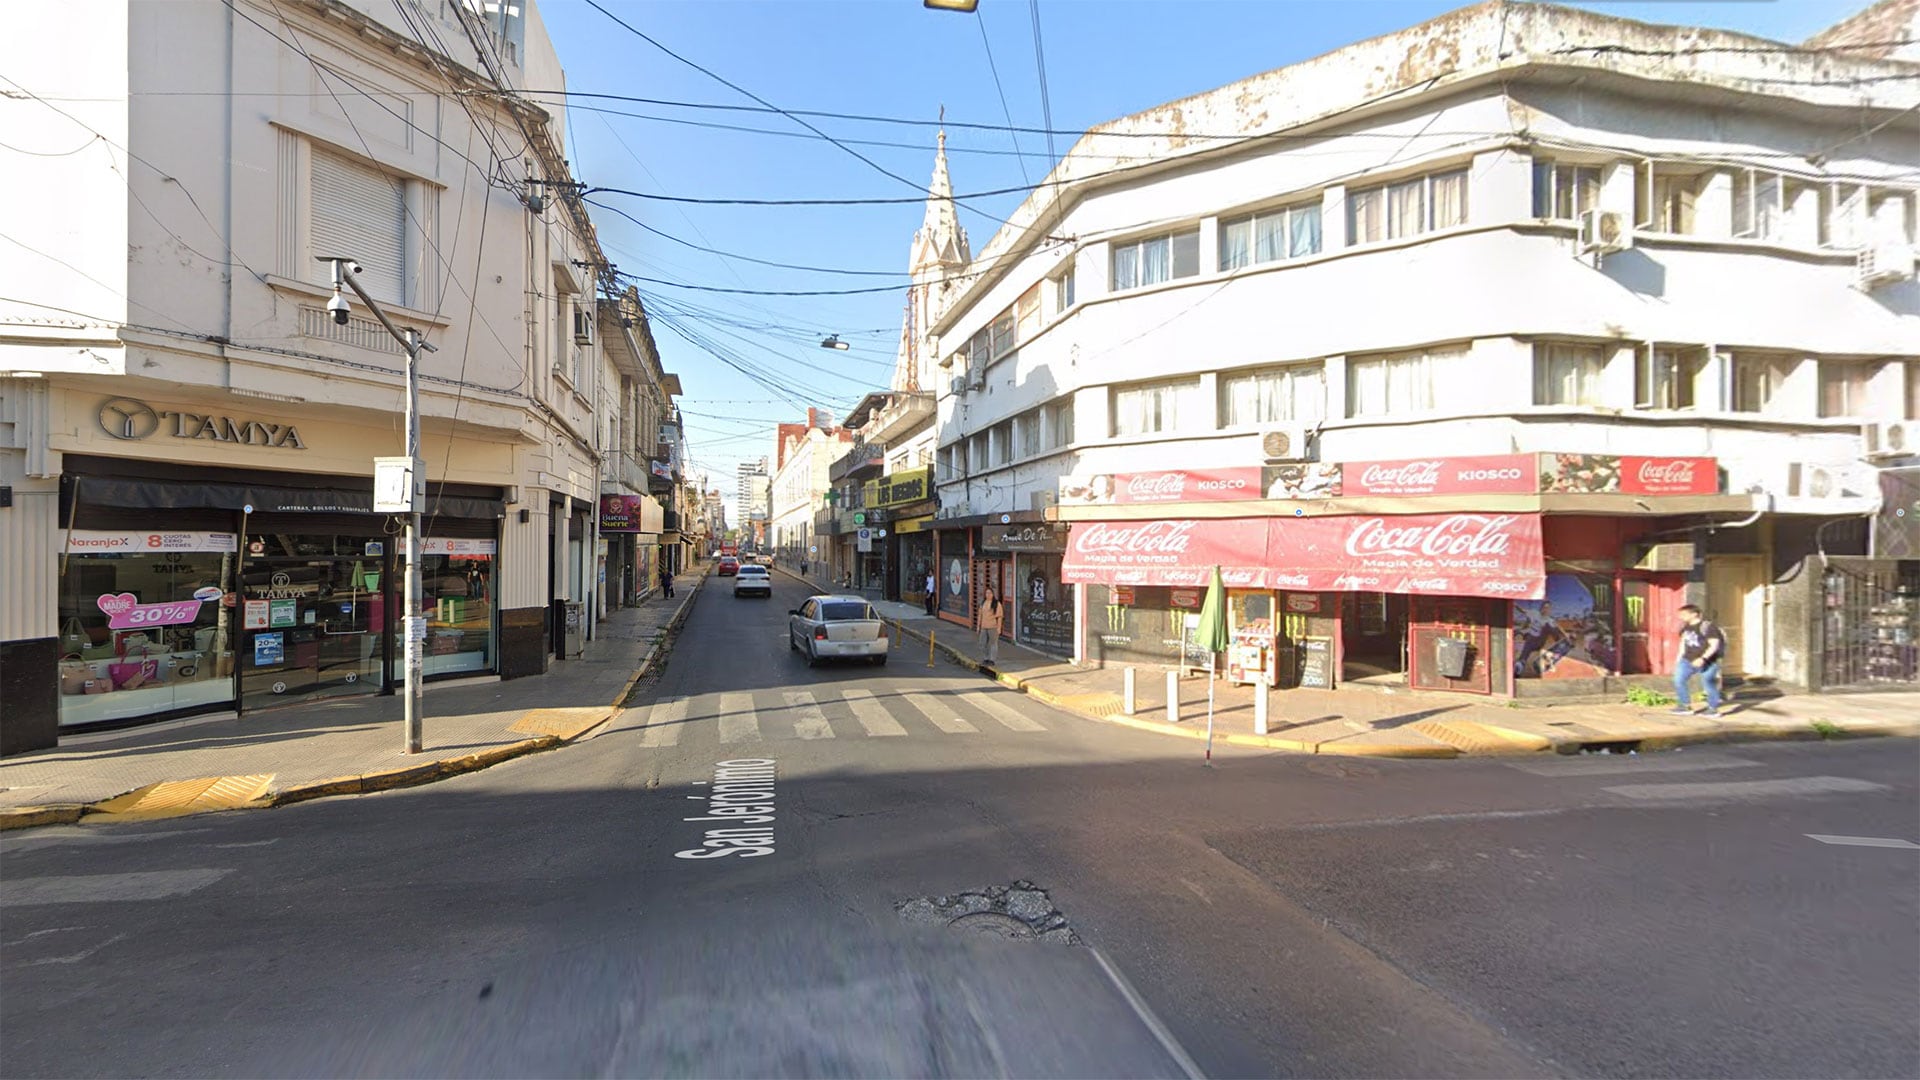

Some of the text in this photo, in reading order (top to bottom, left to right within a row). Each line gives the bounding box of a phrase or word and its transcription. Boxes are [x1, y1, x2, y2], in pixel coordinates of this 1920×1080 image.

[160, 411, 309, 450] TAMYA
[1361, 460, 1521, 487] Coca-Cola KIOSCO
[1127, 473, 1246, 494] Coca-Cola KIOSCO
[602, 519, 629, 527] Suerte
[147, 534, 162, 548] 8
[1076, 521, 1199, 553] Coca-Cola
[1345, 514, 1520, 557] Coca-Cola
[1363, 558, 1499, 569] Magia de Verdad
[257, 588, 306, 599] TAMYA
[103, 601, 132, 610] MADRE
[129, 606, 185, 623] 30%
